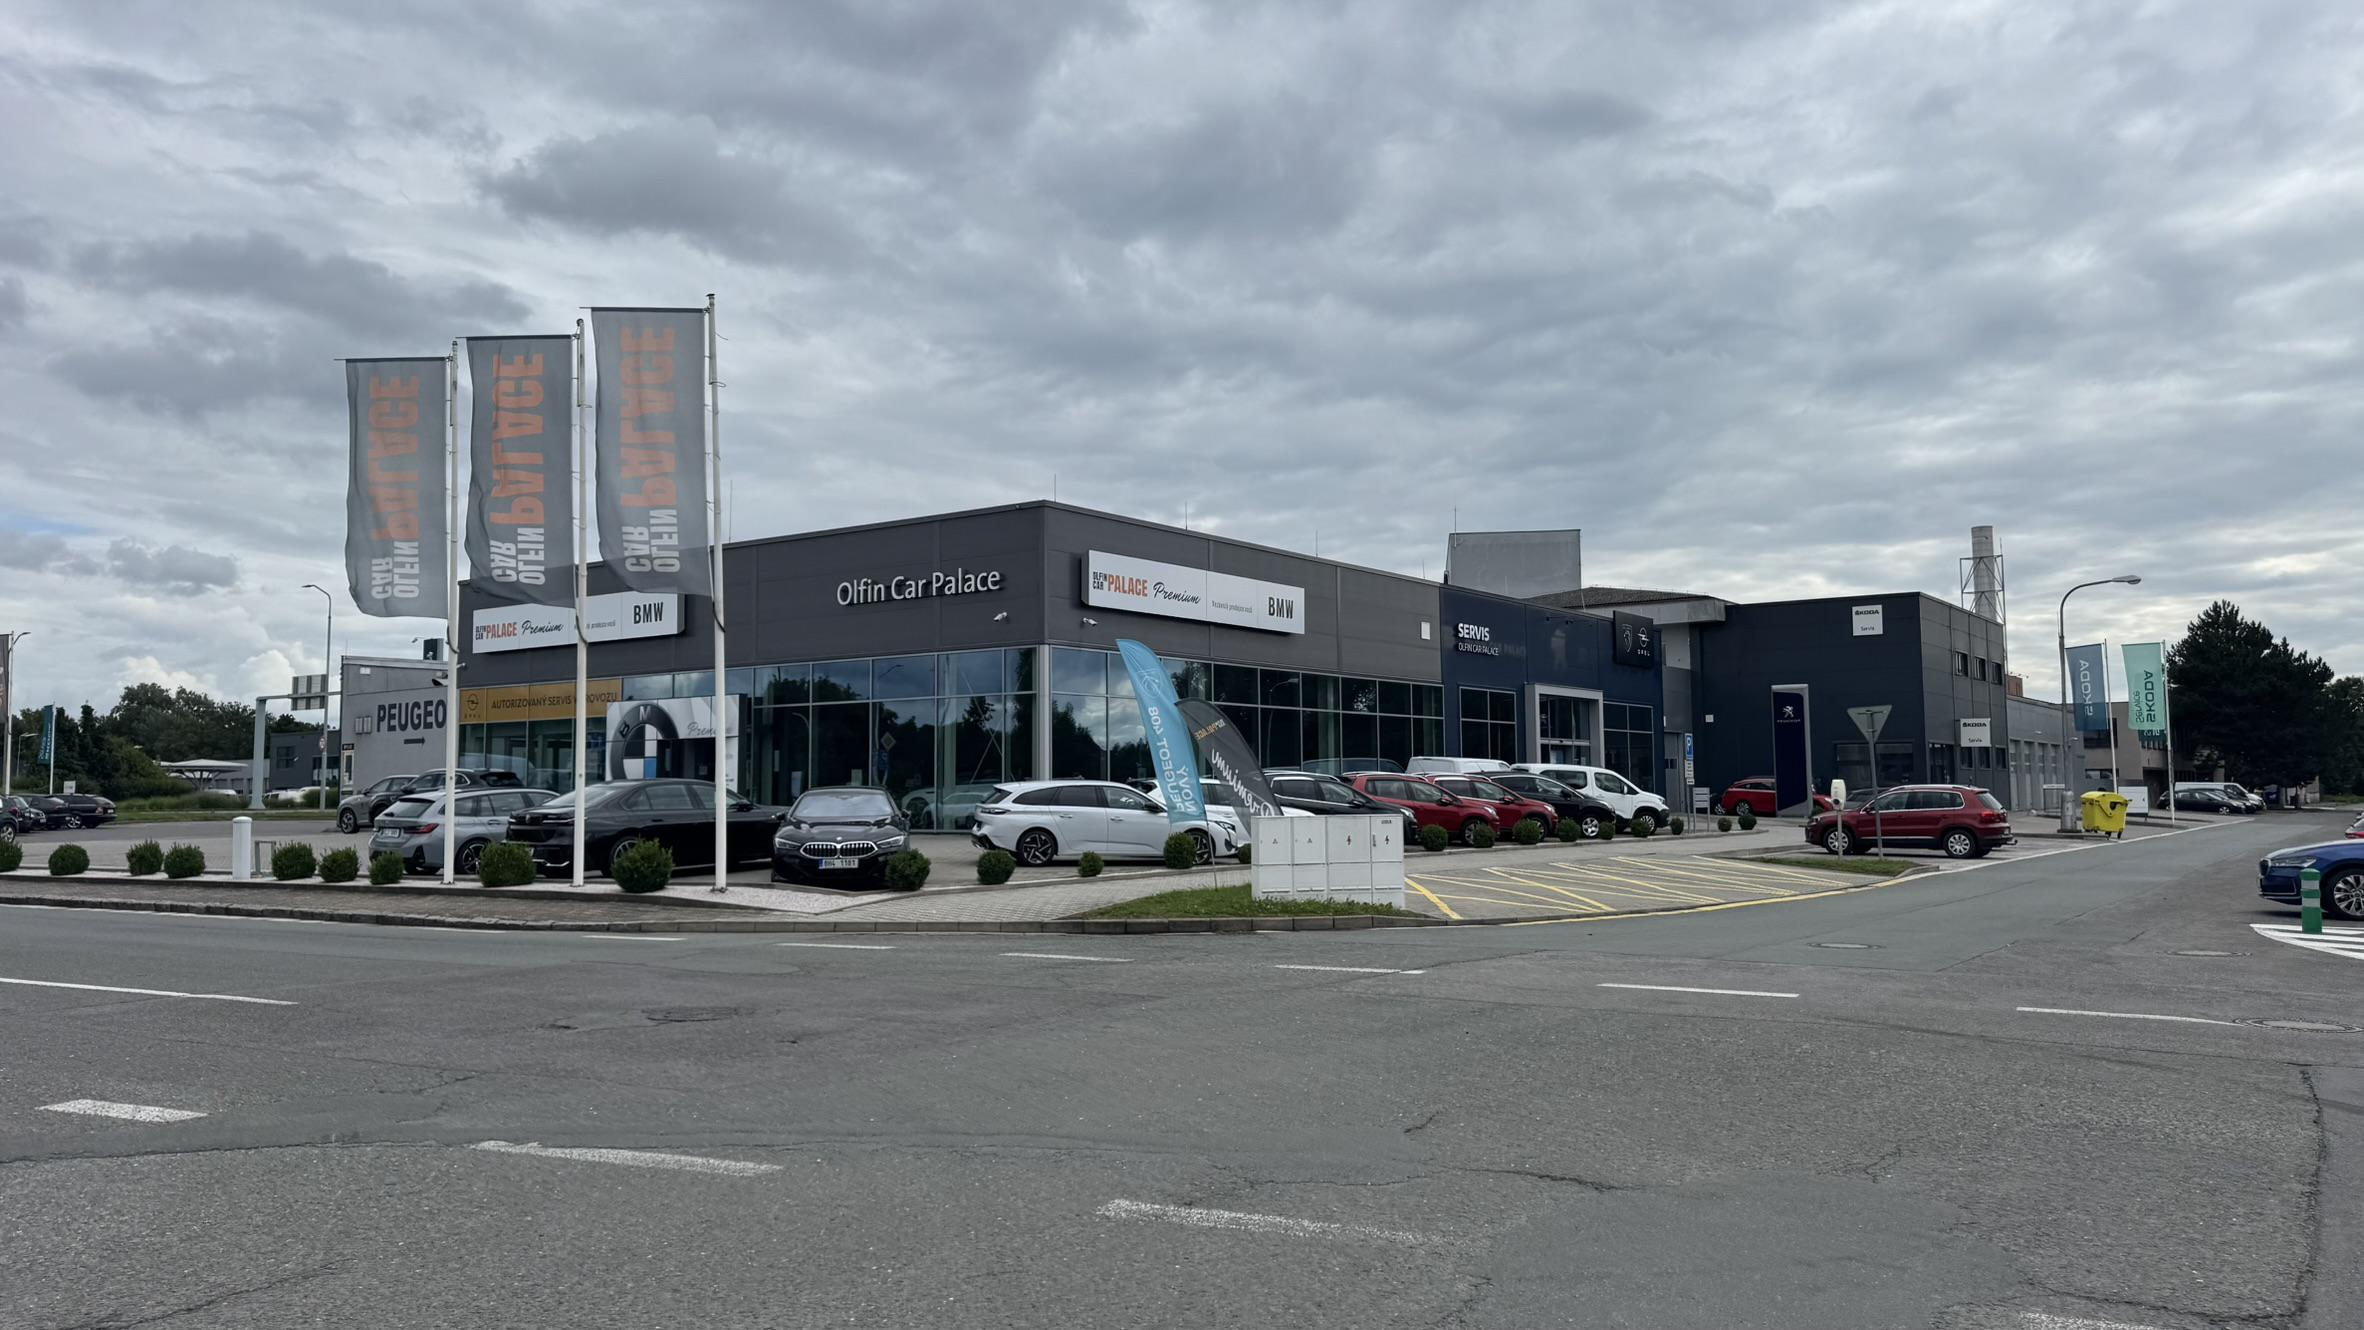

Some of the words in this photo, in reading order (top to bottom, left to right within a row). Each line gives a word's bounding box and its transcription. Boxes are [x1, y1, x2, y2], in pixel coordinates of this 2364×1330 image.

[836, 578, 885, 606] Olfin
[891, 575, 927, 600] Car
[932, 567, 1001, 597] Palace
[1092, 580, 1104, 591] CAR
[1107, 573, 1148, 598] PALACE
[1152, 581, 1202, 605] Premium
[633, 601, 665, 625] BMW
[1267, 596, 1295, 620] BMW
[485, 621, 518, 640] PALACE
[520, 619, 564, 636] Premium
[1457, 622, 1490, 642] SERVIS
[490, 695, 547, 710] AUTORIZOVANÝ
[548, 694, 572, 708] SERVIS
[376, 699, 447, 733] PEUGEO
